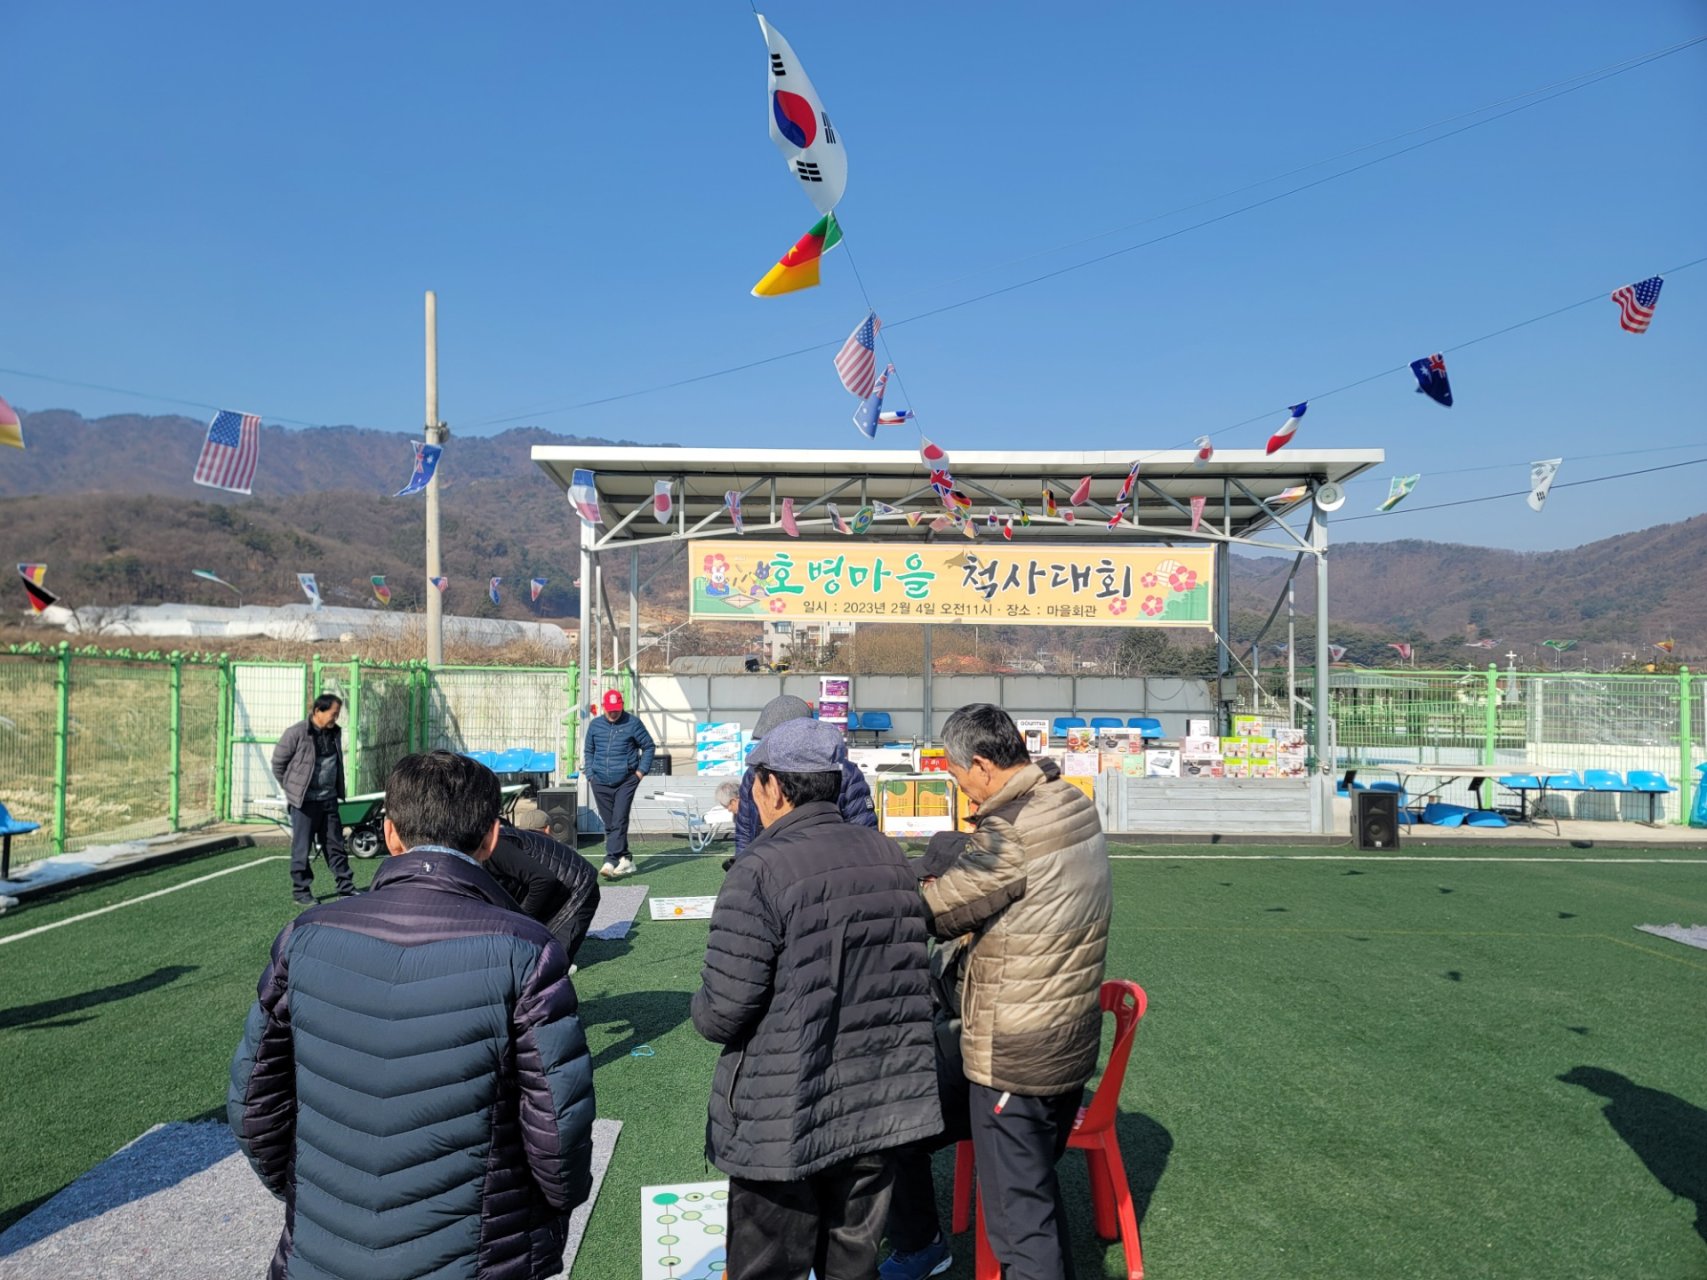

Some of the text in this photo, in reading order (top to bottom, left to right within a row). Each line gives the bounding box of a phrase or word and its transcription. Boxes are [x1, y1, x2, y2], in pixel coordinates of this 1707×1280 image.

[765, 553, 1132, 599] 호병마을 척사대회
[803, 601, 827, 613] 일시
[843, 602, 886, 614] 2023년
[891, 602, 911, 614] 2월
[915, 602, 936, 615] 4일
[940, 602, 993, 616] 오전11시
[1006, 604, 1031, 616] 장소
[1046, 605, 1097, 617] 마을회관
